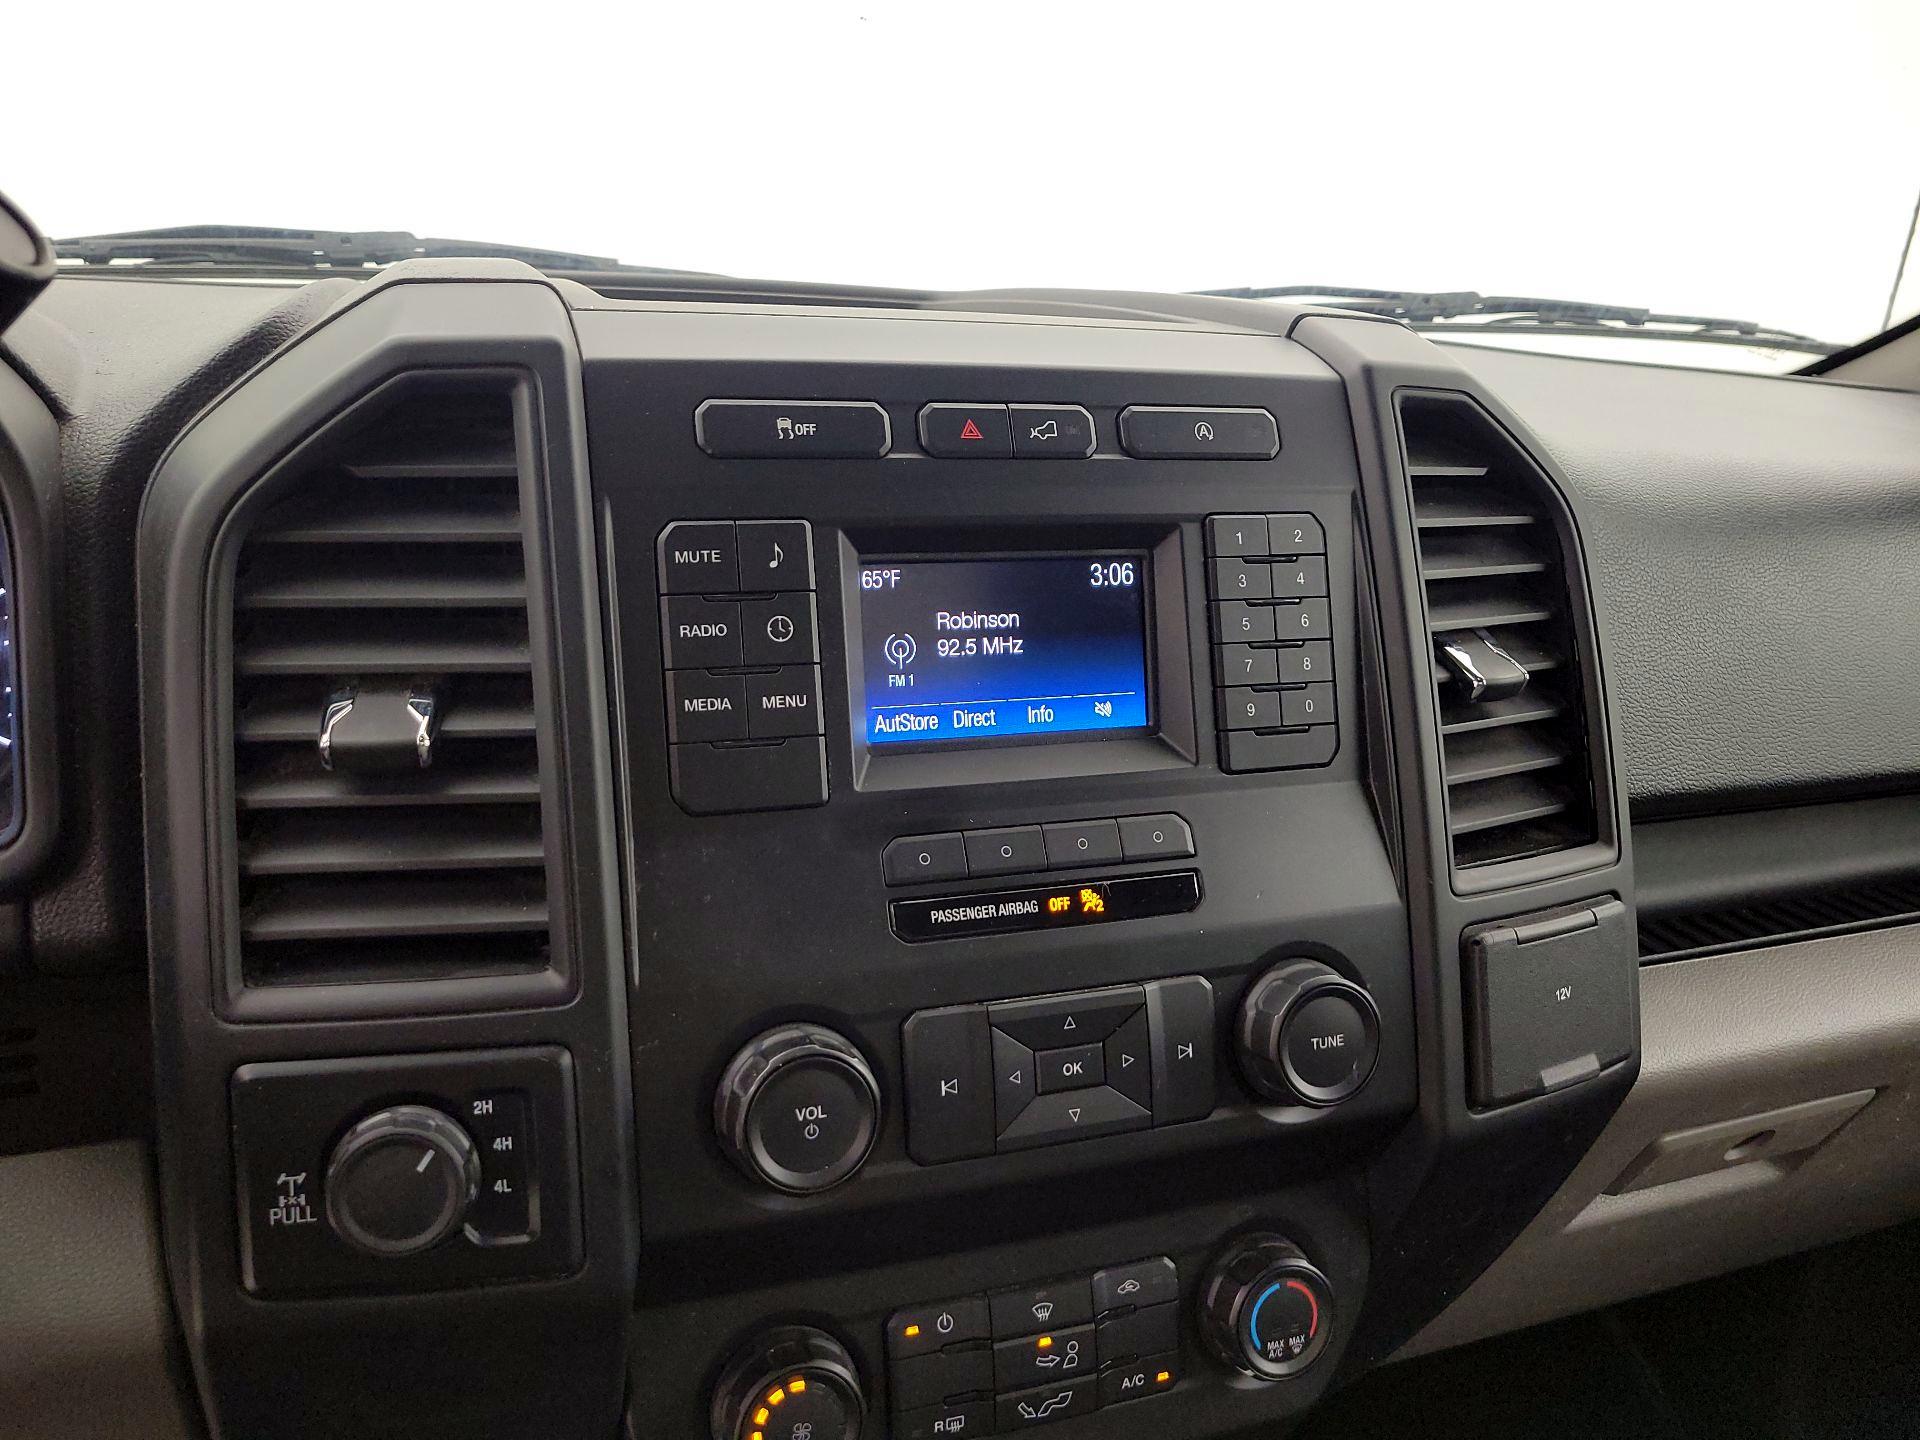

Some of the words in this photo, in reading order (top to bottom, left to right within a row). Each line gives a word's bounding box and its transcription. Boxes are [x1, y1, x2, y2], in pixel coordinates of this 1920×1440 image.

[795, 424, 816, 436] OFF
[1235, 532, 1243, 545] 1
[1294, 530, 1303, 543] 2
[675, 550, 721, 563] MUTE
[1090, 562, 1134, 586] 3:06
[1238, 574, 1247, 588] 3
[1296, 572, 1305, 585] 4
[937, 611, 1020, 631] Robinson
[1242, 618, 1250, 631] 5
[1301, 614, 1309, 627] 6
[679, 624, 727, 638] RADIO
[937, 638, 977, 657] 92.5
[982, 636, 1024, 656] MHz
[1244, 659, 1253, 673] 7
[1303, 657, 1311, 671] 8
[889, 674, 906, 688] FM
[908, 673, 914, 686] 1
[684, 698, 732, 712] MEDIA
[762, 694, 807, 709] MENU
[1305, 700, 1314, 713] 0
[1027, 705, 1054, 724] Info
[1247, 703, 1255, 716] 9
[874, 713, 939, 733] AutStore
[953, 709, 997, 729] Direct
[930, 904, 997, 924] PASSENGER
[998, 900, 1039, 917] AIRBAG
[1049, 897, 1071, 912] OFF
[1555, 985, 1572, 1001] 12V
[1310, 1034, 1345, 1050] TUNE
[1062, 1061, 1083, 1076] OK
[473, 1100, 493, 1115] 2H
[795, 1105, 827, 1122] VOL
[493, 1136, 513, 1151] 4H
[493, 1179, 512, 1193] 4L
[269, 1206, 318, 1226] PULL
[1267, 1339, 1284, 1351] MAX
[1289, 1334, 1305, 1346] MAX
[1268, 1348, 1283, 1359] A/C
[1121, 1373, 1145, 1389] A/C
[934, 1421, 944, 1433] R
